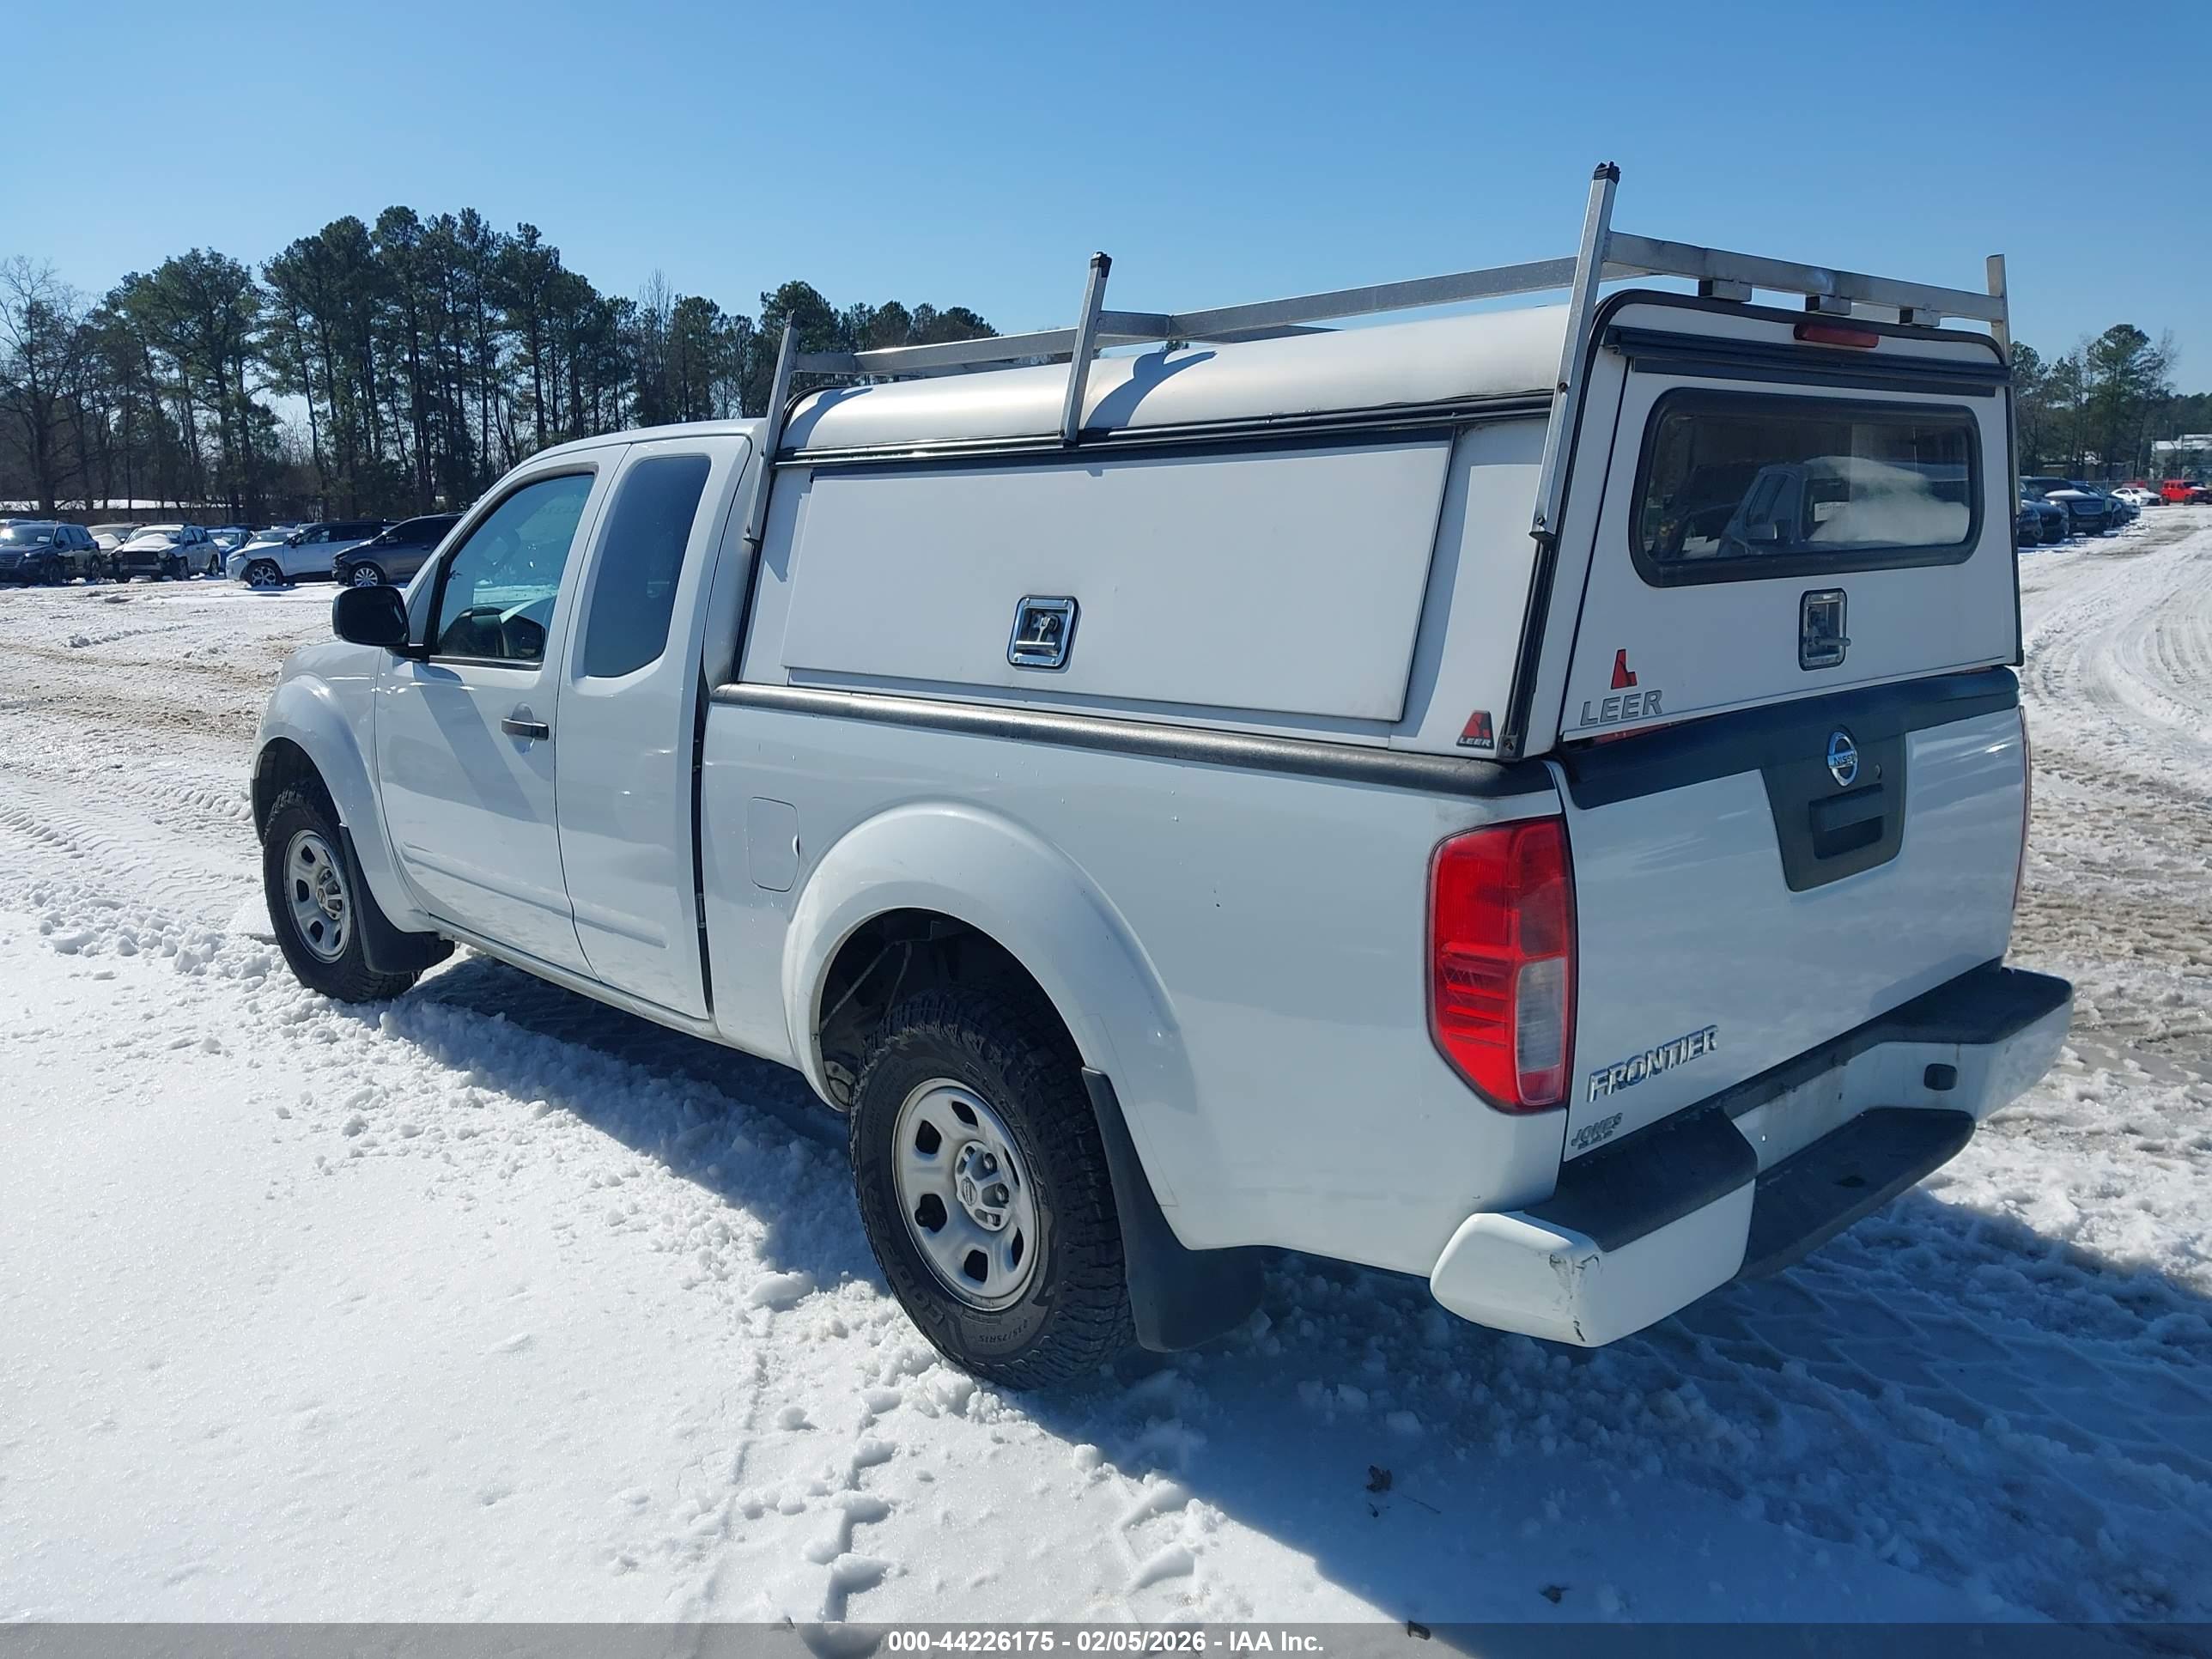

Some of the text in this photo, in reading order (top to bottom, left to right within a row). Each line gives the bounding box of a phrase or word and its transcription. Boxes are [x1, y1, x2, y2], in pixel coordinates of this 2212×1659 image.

[1579, 690, 1663, 726] LEER
[1459, 737, 1492, 747] LEER
[1587, 1024, 1719, 1103] FRONTIER
